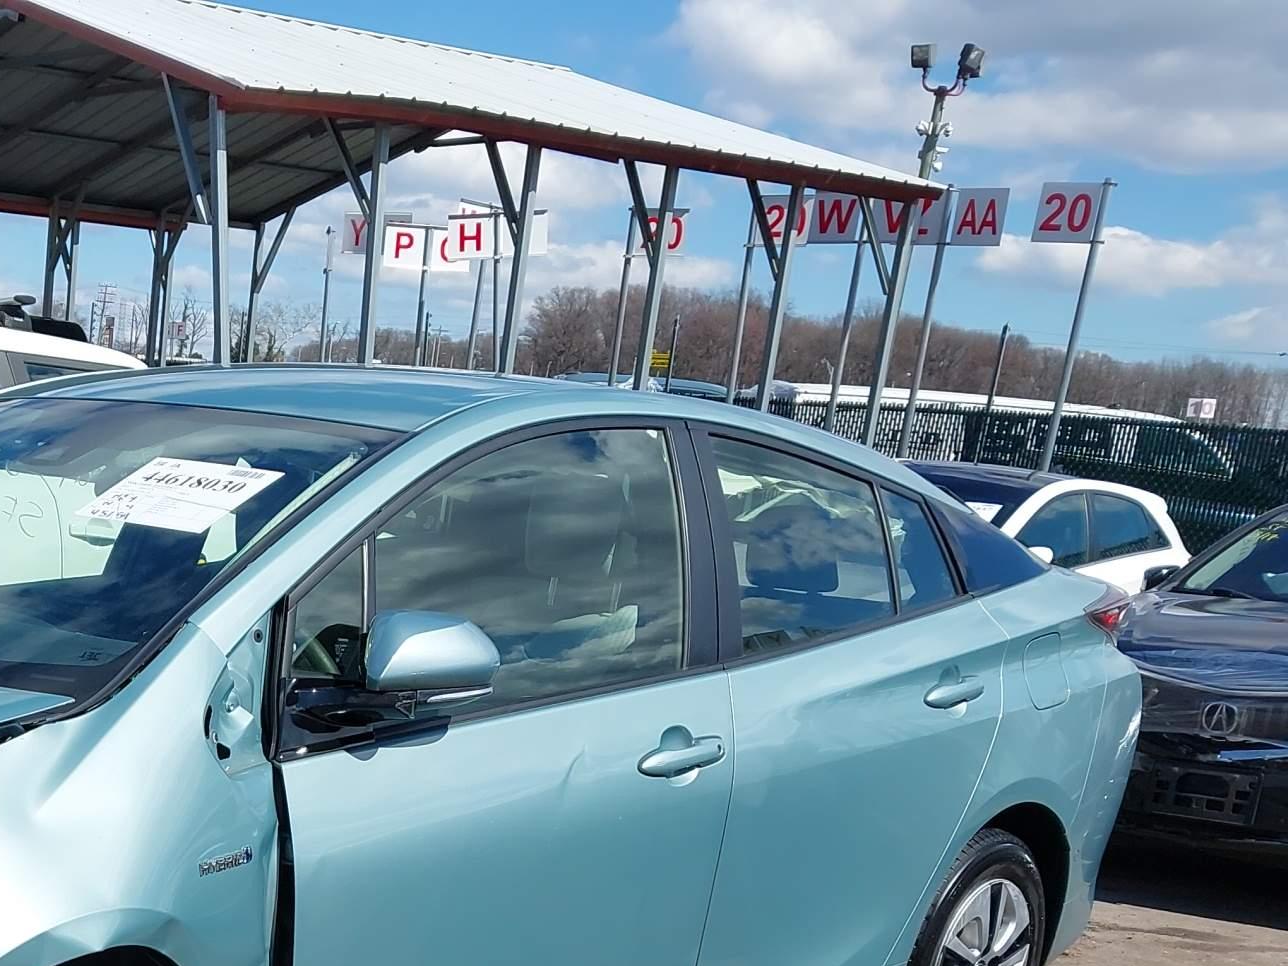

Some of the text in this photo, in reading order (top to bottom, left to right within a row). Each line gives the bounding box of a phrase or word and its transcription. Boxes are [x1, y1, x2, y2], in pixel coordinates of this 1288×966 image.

[818, 199, 857, 234] W
[957, 199, 997, 235] AA
[1039, 193, 1092, 232] 20
[350, 219, 368, 247] Y
[393, 231, 415, 259] P
[459, 222, 482, 252] H
[142, 471, 247, 493] 44618030
